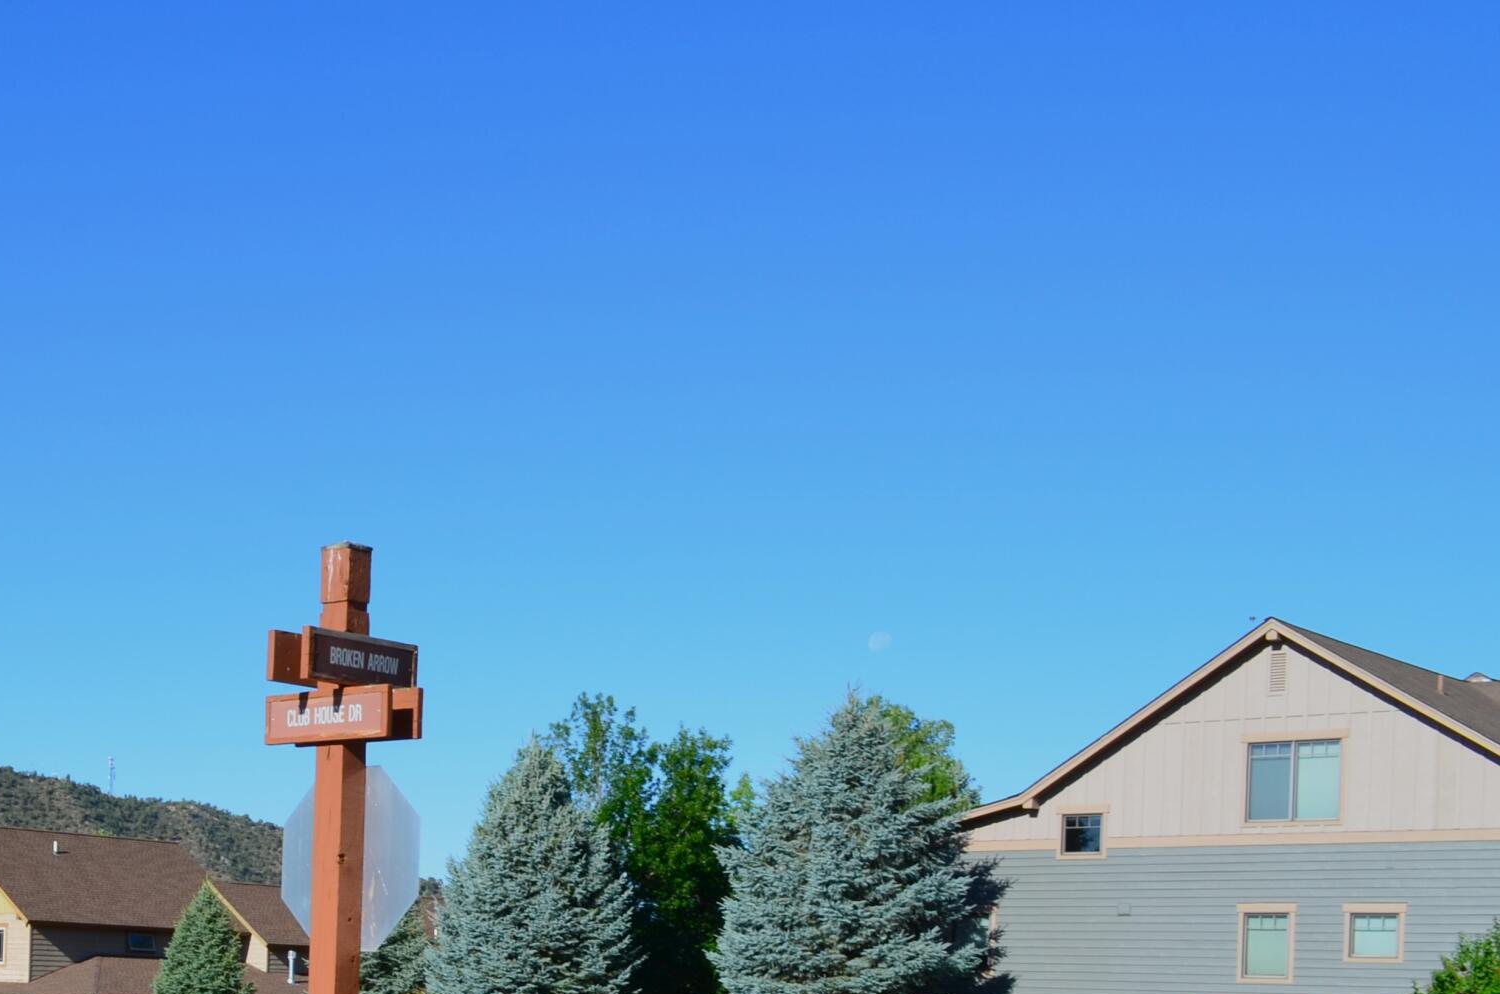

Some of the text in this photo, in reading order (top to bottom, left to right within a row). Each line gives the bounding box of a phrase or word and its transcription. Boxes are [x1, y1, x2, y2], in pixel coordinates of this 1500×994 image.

[329, 646, 399, 675] BROKEN ARROW
[287, 704, 362, 727] CLUB HOUSE DR
